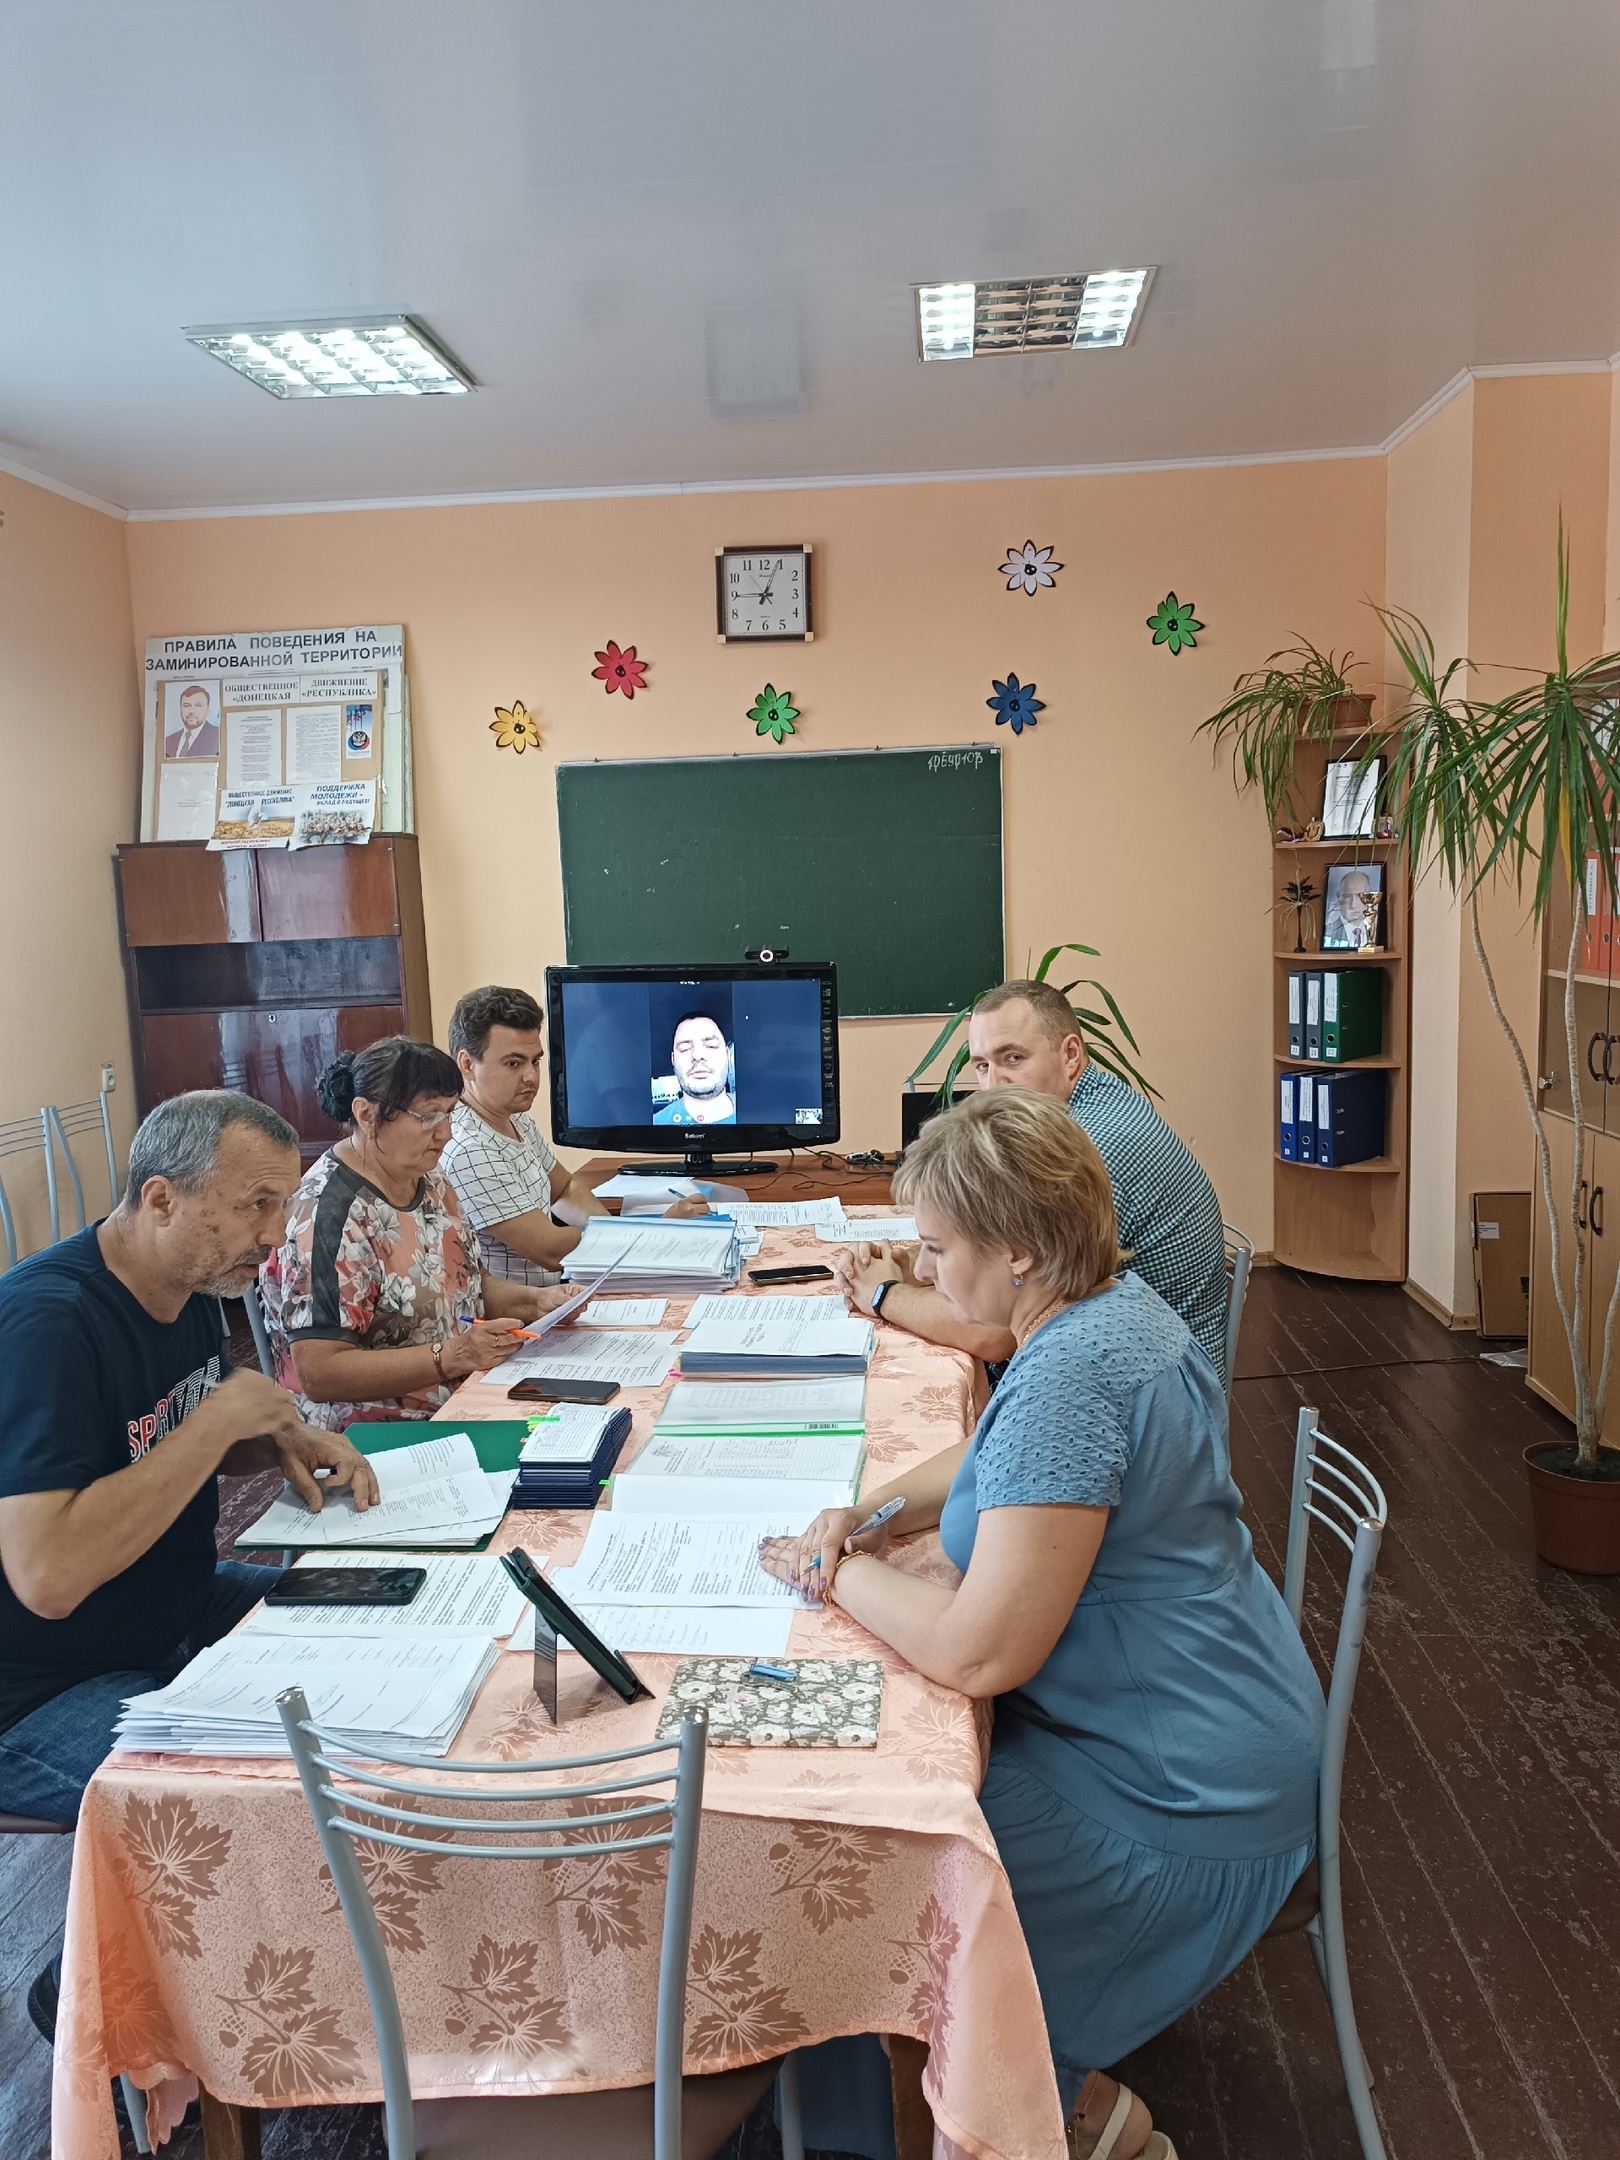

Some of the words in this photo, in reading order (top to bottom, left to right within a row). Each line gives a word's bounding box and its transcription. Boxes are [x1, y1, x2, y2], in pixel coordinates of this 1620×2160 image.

[743, 560, 752, 571] 11
[759, 559, 770, 570] 12
[779, 559, 784, 570] 1
[730, 573, 740, 583] 10
[791, 570, 798, 581] 2
[731, 591, 738, 601] 9
[792, 589, 798, 599] 3
[731, 609, 738, 619] 8
[792, 607, 799, 618] 4
[745, 620, 752, 631] 7
[762, 620, 769, 630] 6
[779, 619, 786, 630] 5
[165, 638, 237, 653] ПРАВИЛА
[250, 632, 345, 649] ПОВЕДЕНИЯ
[356, 630, 377, 642] НА
[145, 651, 293, 671] ЗАМИНИРОВАННОЙ
[300, 645, 402, 664] ТЕРРИТОРИИ
[225, 682, 298, 693] ОБЩЕСТВЕННОЕ
[232, 692, 291, 703] «ДОНЕЦКАЯ
[301, 688, 376, 697] «РЕСПУБЛИКА»
[316, 783, 366, 792] ПОДДЕРЖКА
